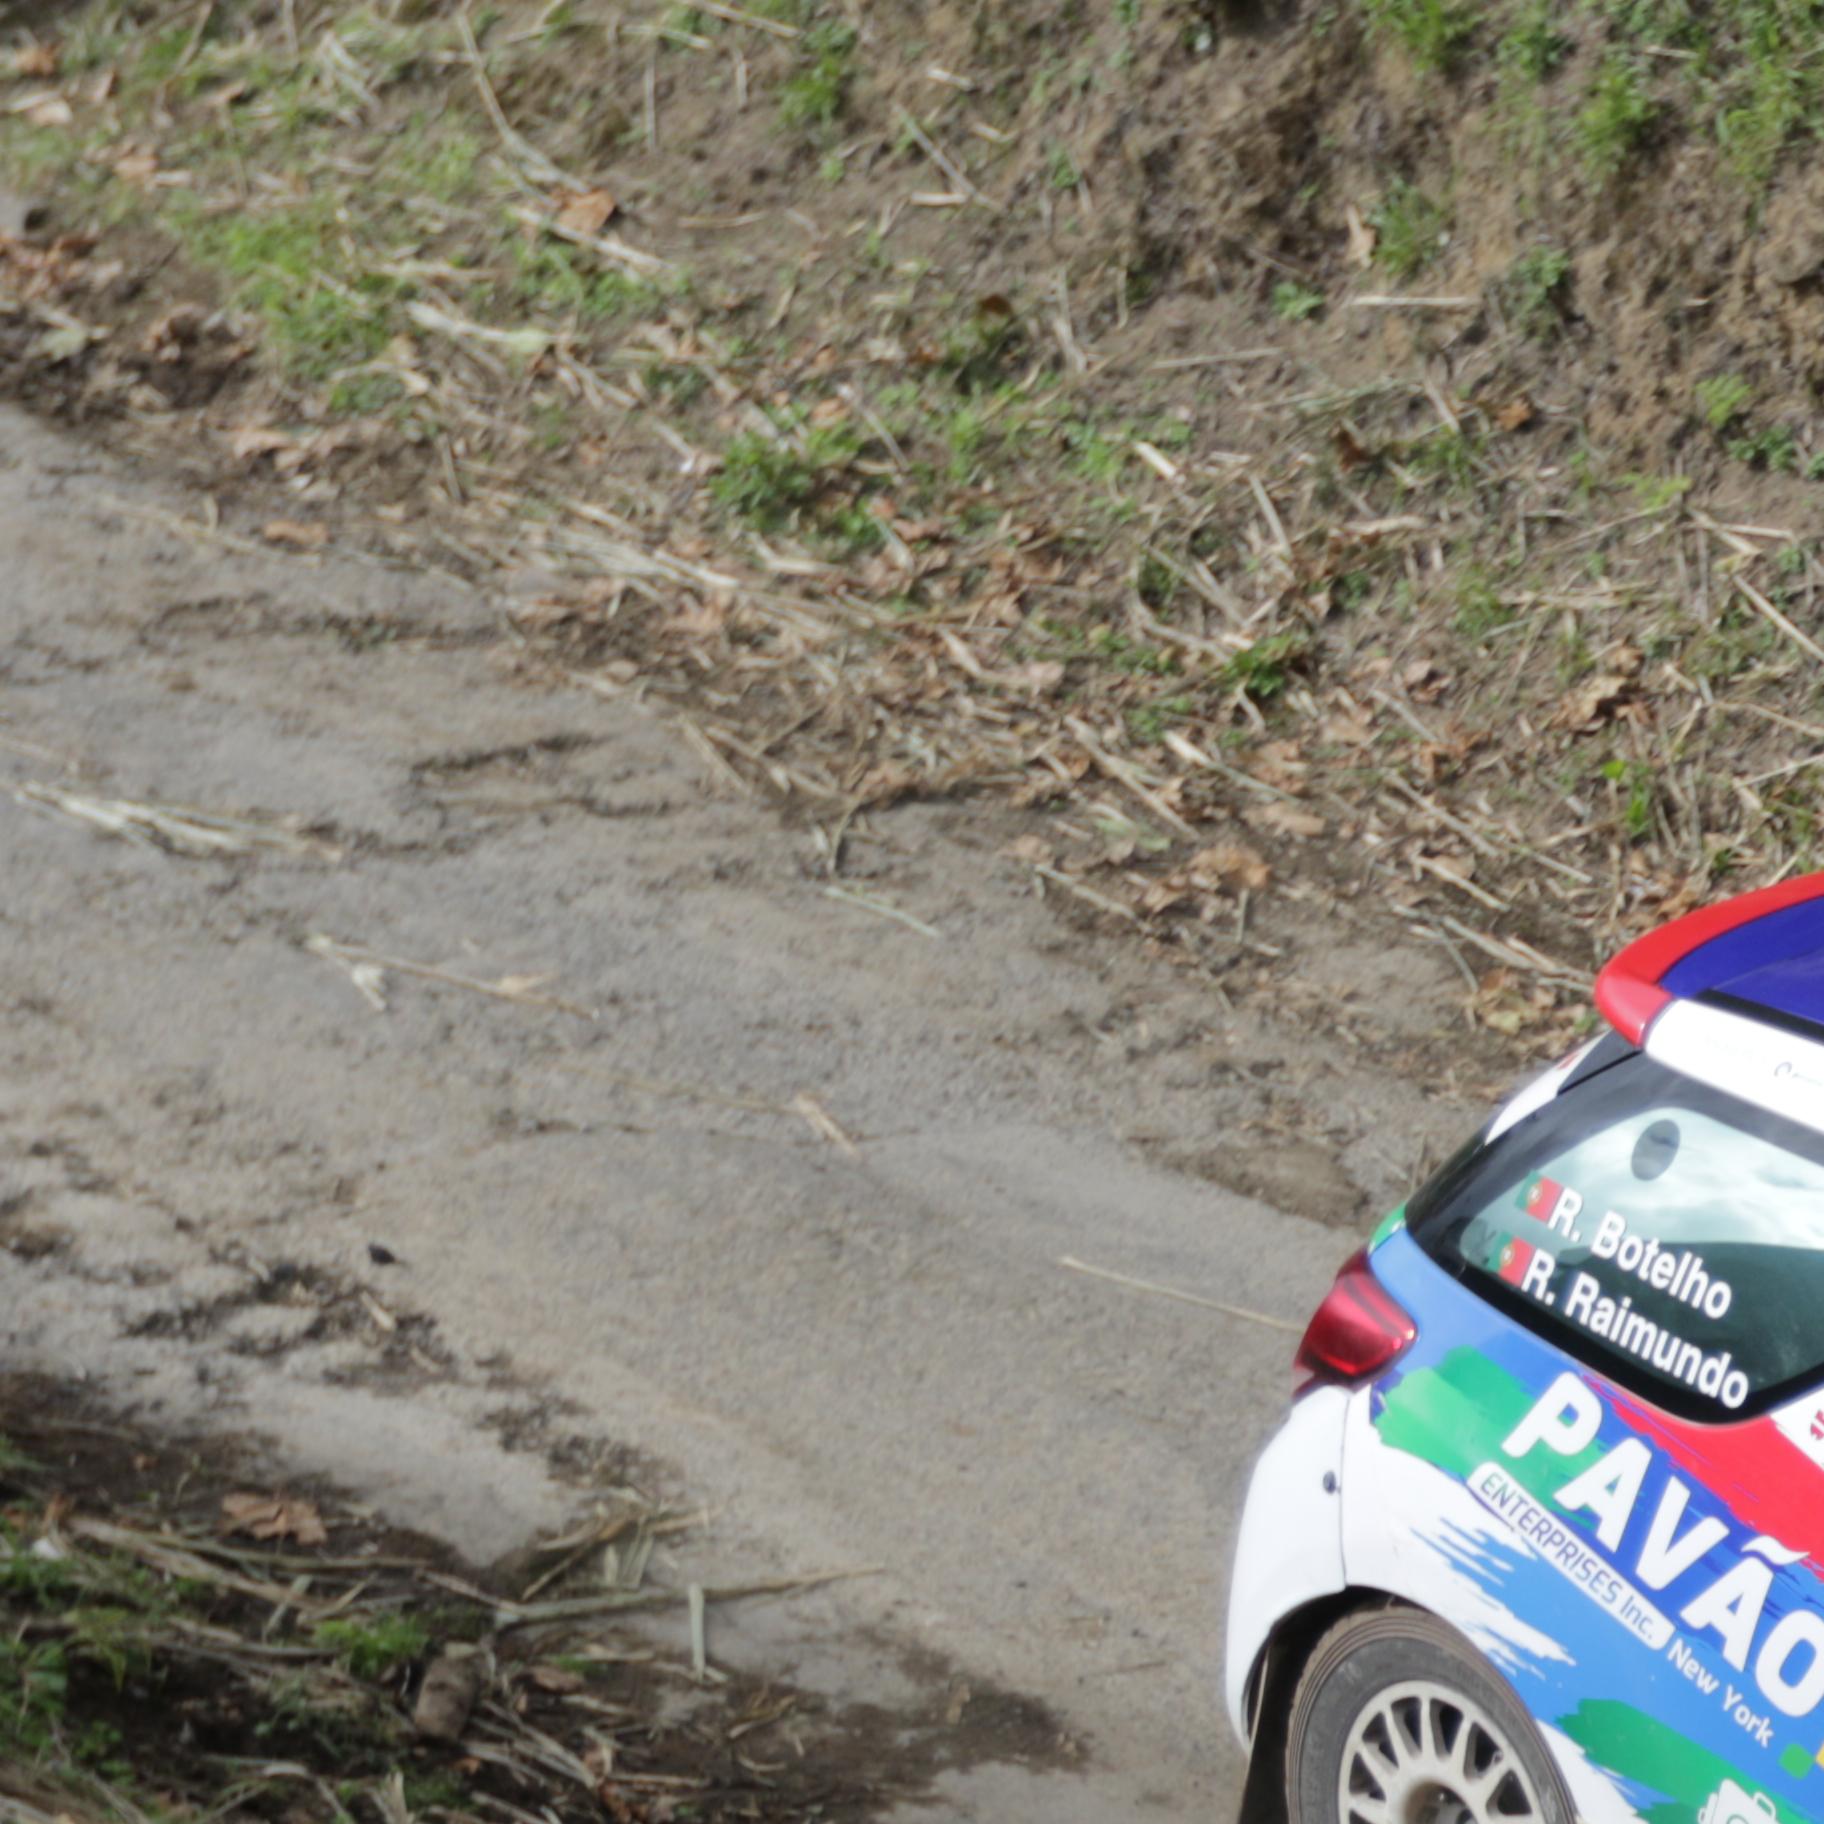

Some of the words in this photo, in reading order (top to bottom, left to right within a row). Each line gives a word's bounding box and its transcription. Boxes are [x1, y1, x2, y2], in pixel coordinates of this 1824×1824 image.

[1521, 1249, 1555, 1306] R.
[1565, 1272, 1748, 1408] Raimundo
[1548, 1187, 1582, 1242] R.
[1591, 1210, 1731, 1319] Botelho
[1479, 1472, 1622, 1602] ENTERPRISES
[1619, 1595, 1654, 1640] Inc.
[1668, 1638, 1720, 1696] New
[1722, 1685, 1776, 1748] York
